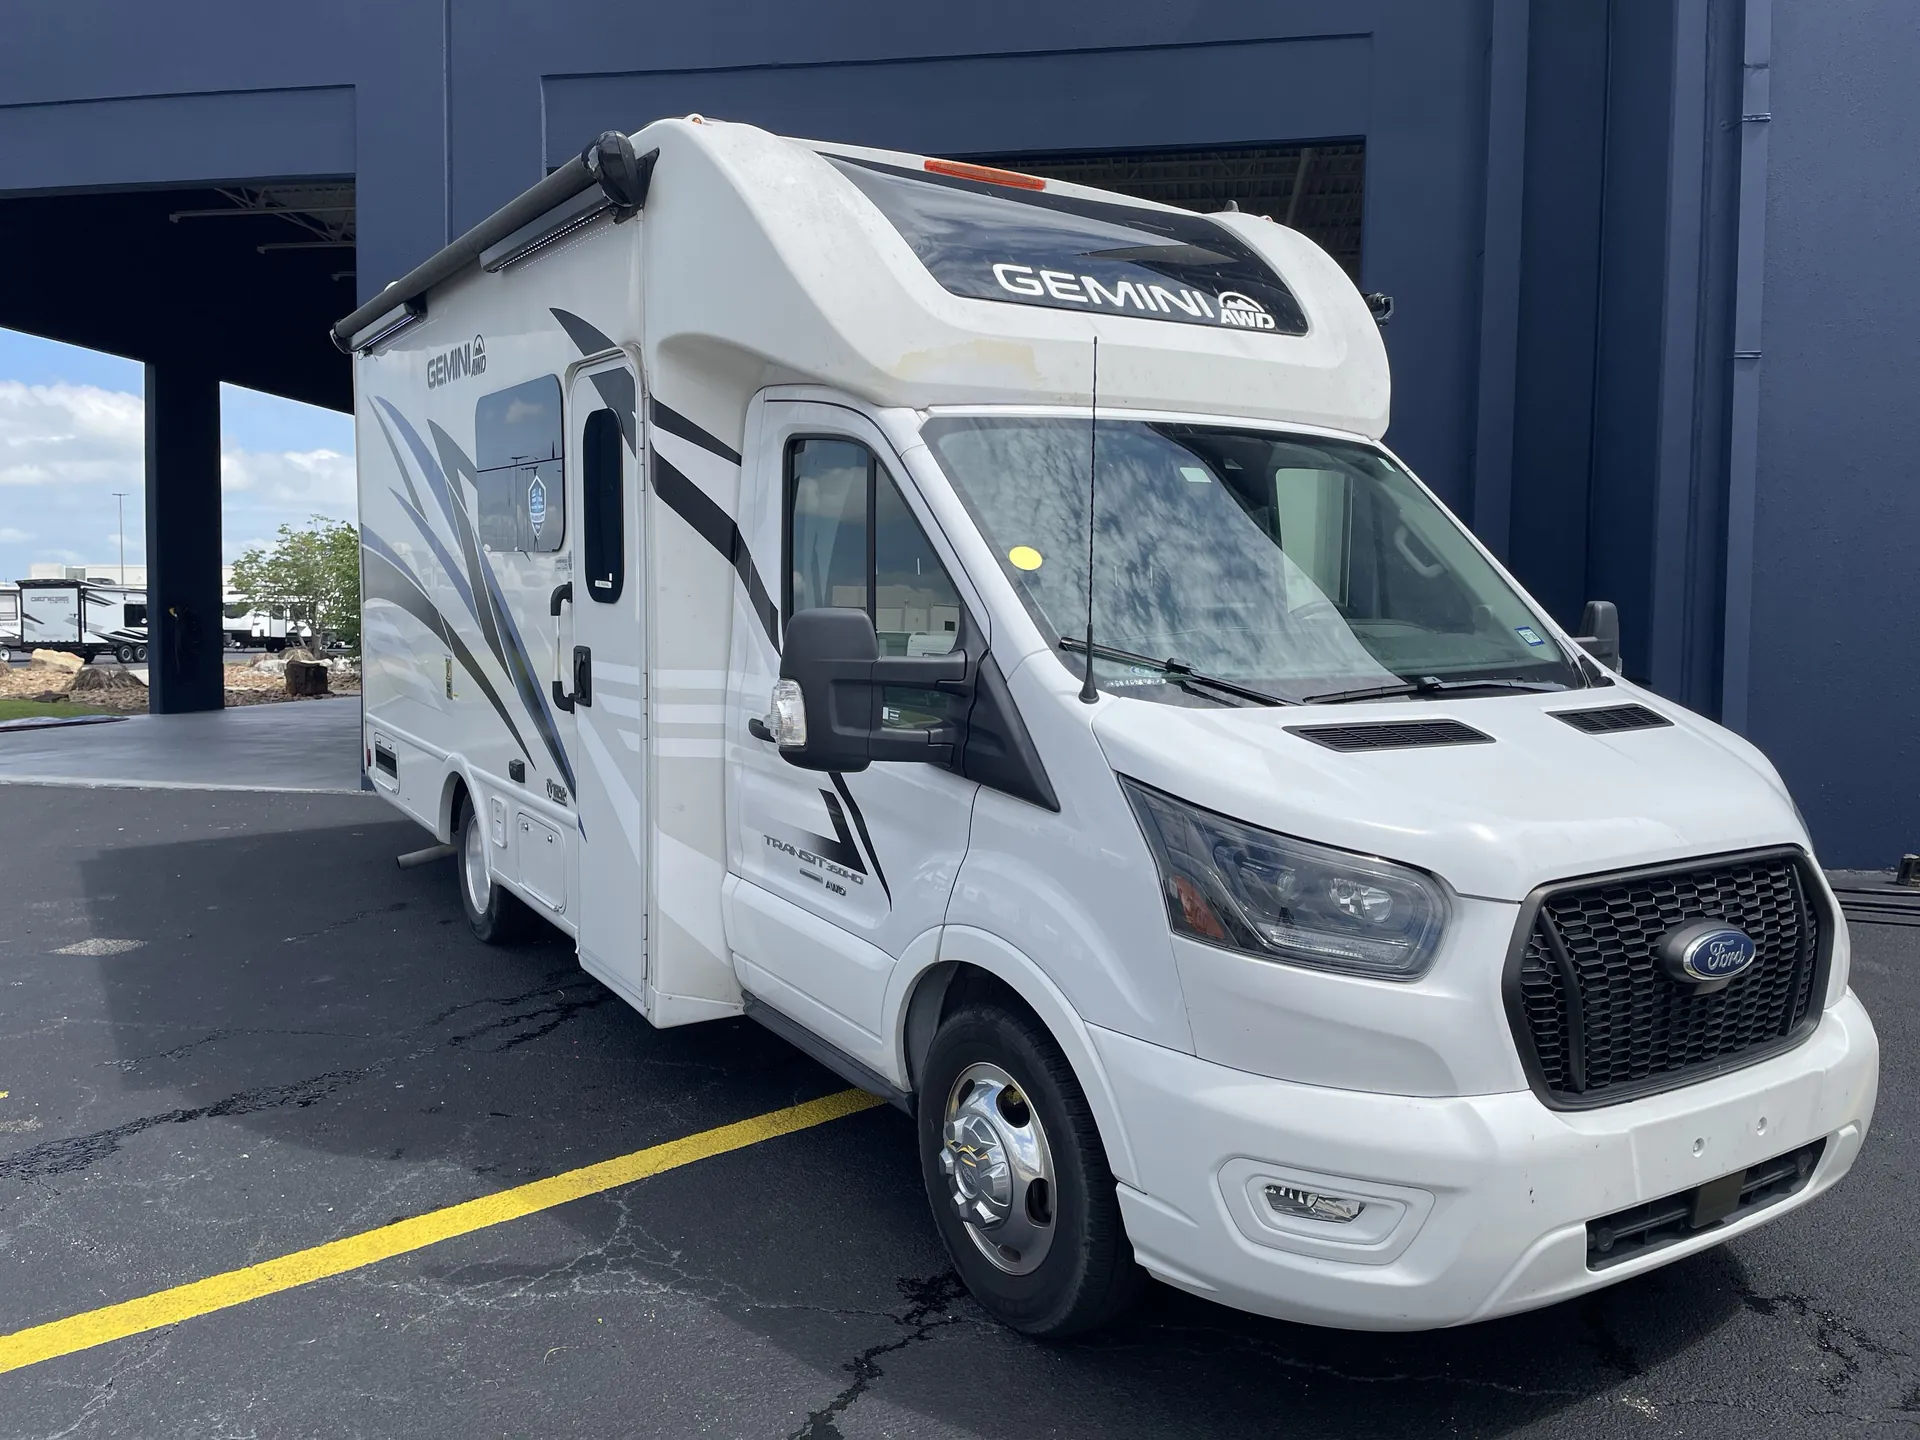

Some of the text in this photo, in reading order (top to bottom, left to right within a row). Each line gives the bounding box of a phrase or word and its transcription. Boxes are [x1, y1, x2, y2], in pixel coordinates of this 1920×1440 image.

[992, 263, 1275, 329] GEMINI AWD
[427, 342, 486, 390] GEMINI AWD
[825, 880, 846, 896] AWD
[1707, 939, 1745, 970] Ford
